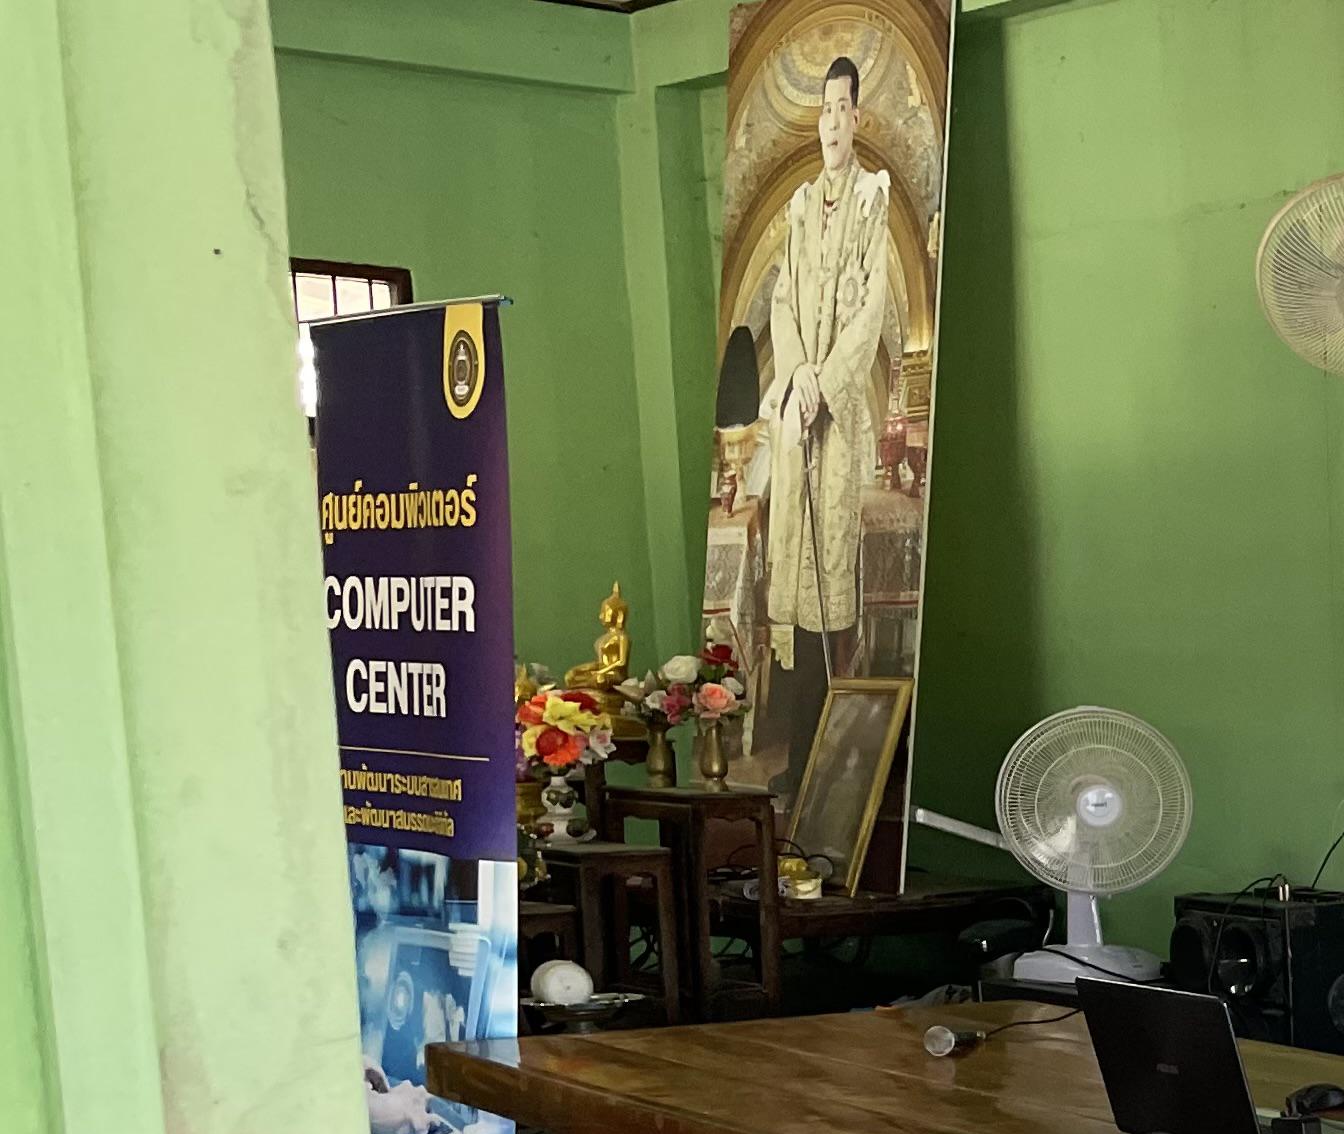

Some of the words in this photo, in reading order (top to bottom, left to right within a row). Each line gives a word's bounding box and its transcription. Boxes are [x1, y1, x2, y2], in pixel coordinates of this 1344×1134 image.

[322, 474, 477, 545] ศูนย์คอมพิวเตอร์
[325, 576, 475, 632] COMPUTER
[346, 659, 446, 717] CENTER
